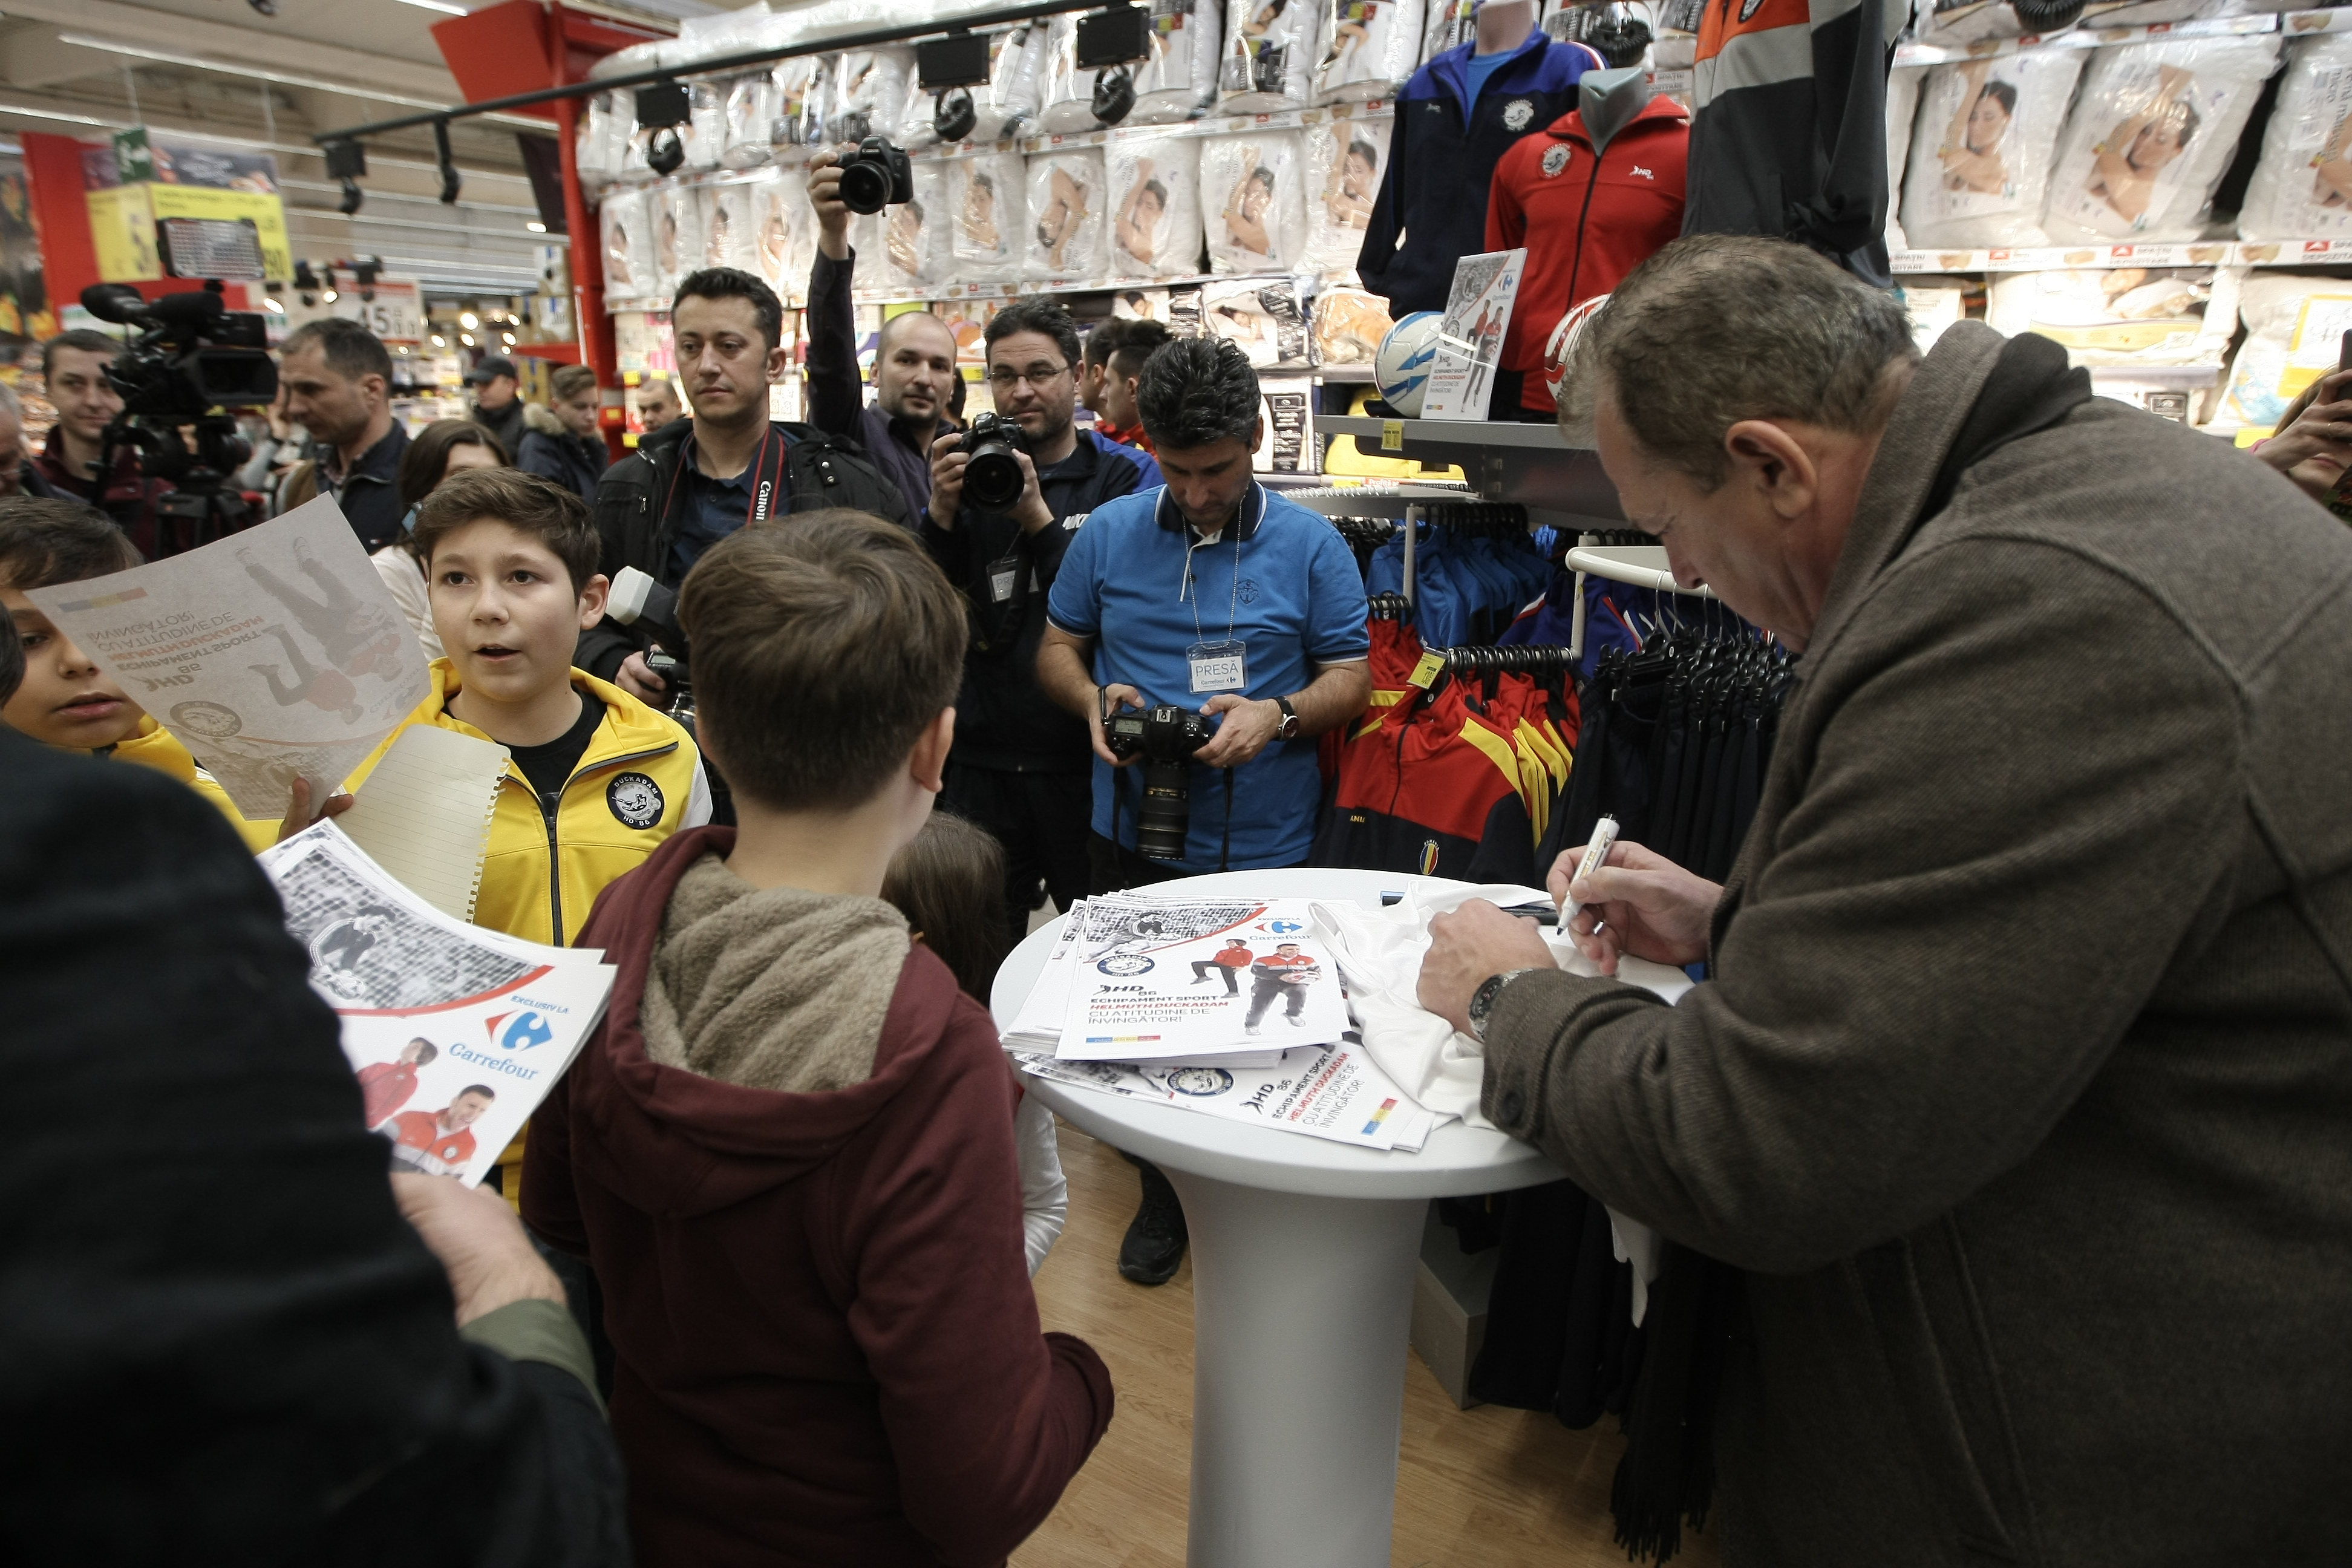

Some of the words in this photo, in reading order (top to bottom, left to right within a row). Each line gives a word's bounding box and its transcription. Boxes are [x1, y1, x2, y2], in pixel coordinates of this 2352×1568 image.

[755, 480, 771, 520] Canon
[1196, 659, 1239, 677] PRESĂ
[614, 776, 658, 794] DUCKADAM
[1104, 954, 1149, 962] DUCKADAM
[511, 996, 556, 1011] EXCLUSIV
[1088, 1016, 1182, 1024] ÎNVINGĂTOR!
[448, 1043, 538, 1080] Carrefour
[1253, 1083, 1275, 1103] HD
[1272, 1074, 1313, 1119] ECHIPAMENT
[1309, 1054, 1332, 1076] SPORT
[1277, 1079, 1292, 1091] 86
[1289, 1087, 1320, 1122] HELMUTH
[1316, 1053, 1350, 1088] DUCKADAM
[1302, 1111, 1316, 1125] CU
[1316, 1073, 1349, 1113] ATITUDINE
[1345, 1063, 1360, 1075] DE
[1315, 1079, 1365, 1129] ÎNVINGĂTOR!
